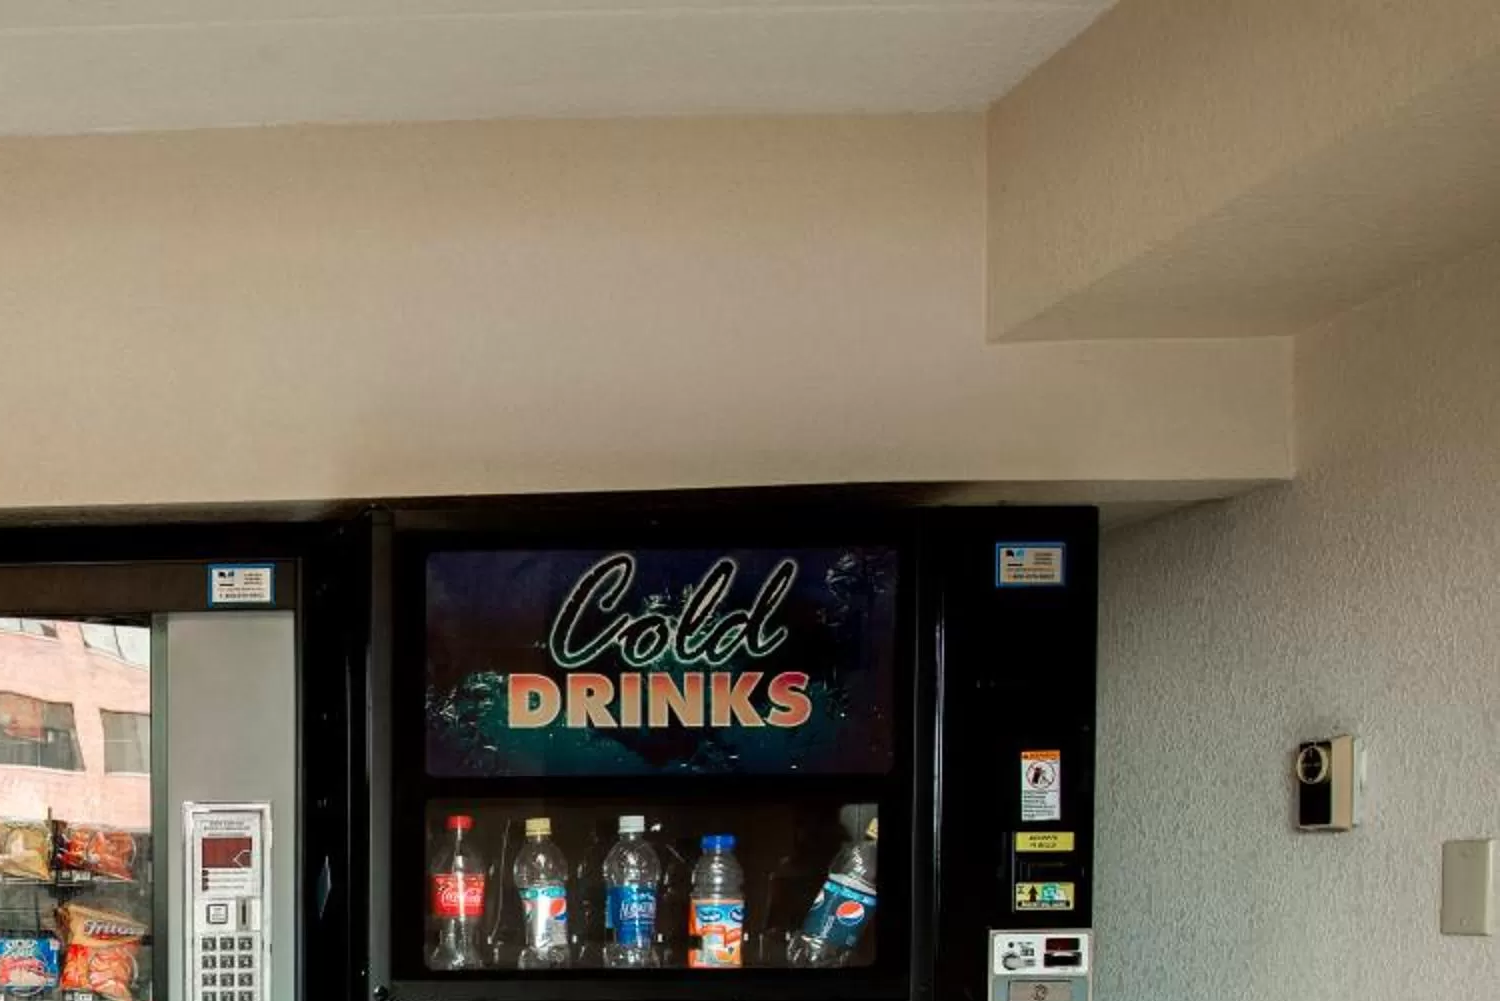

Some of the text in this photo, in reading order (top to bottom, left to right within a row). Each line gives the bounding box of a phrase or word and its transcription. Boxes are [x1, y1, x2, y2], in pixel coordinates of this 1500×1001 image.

[549, 552, 799, 669] Cold
[507, 671, 813, 730] DRINKS
[83, 919, 145, 937] Fritos
